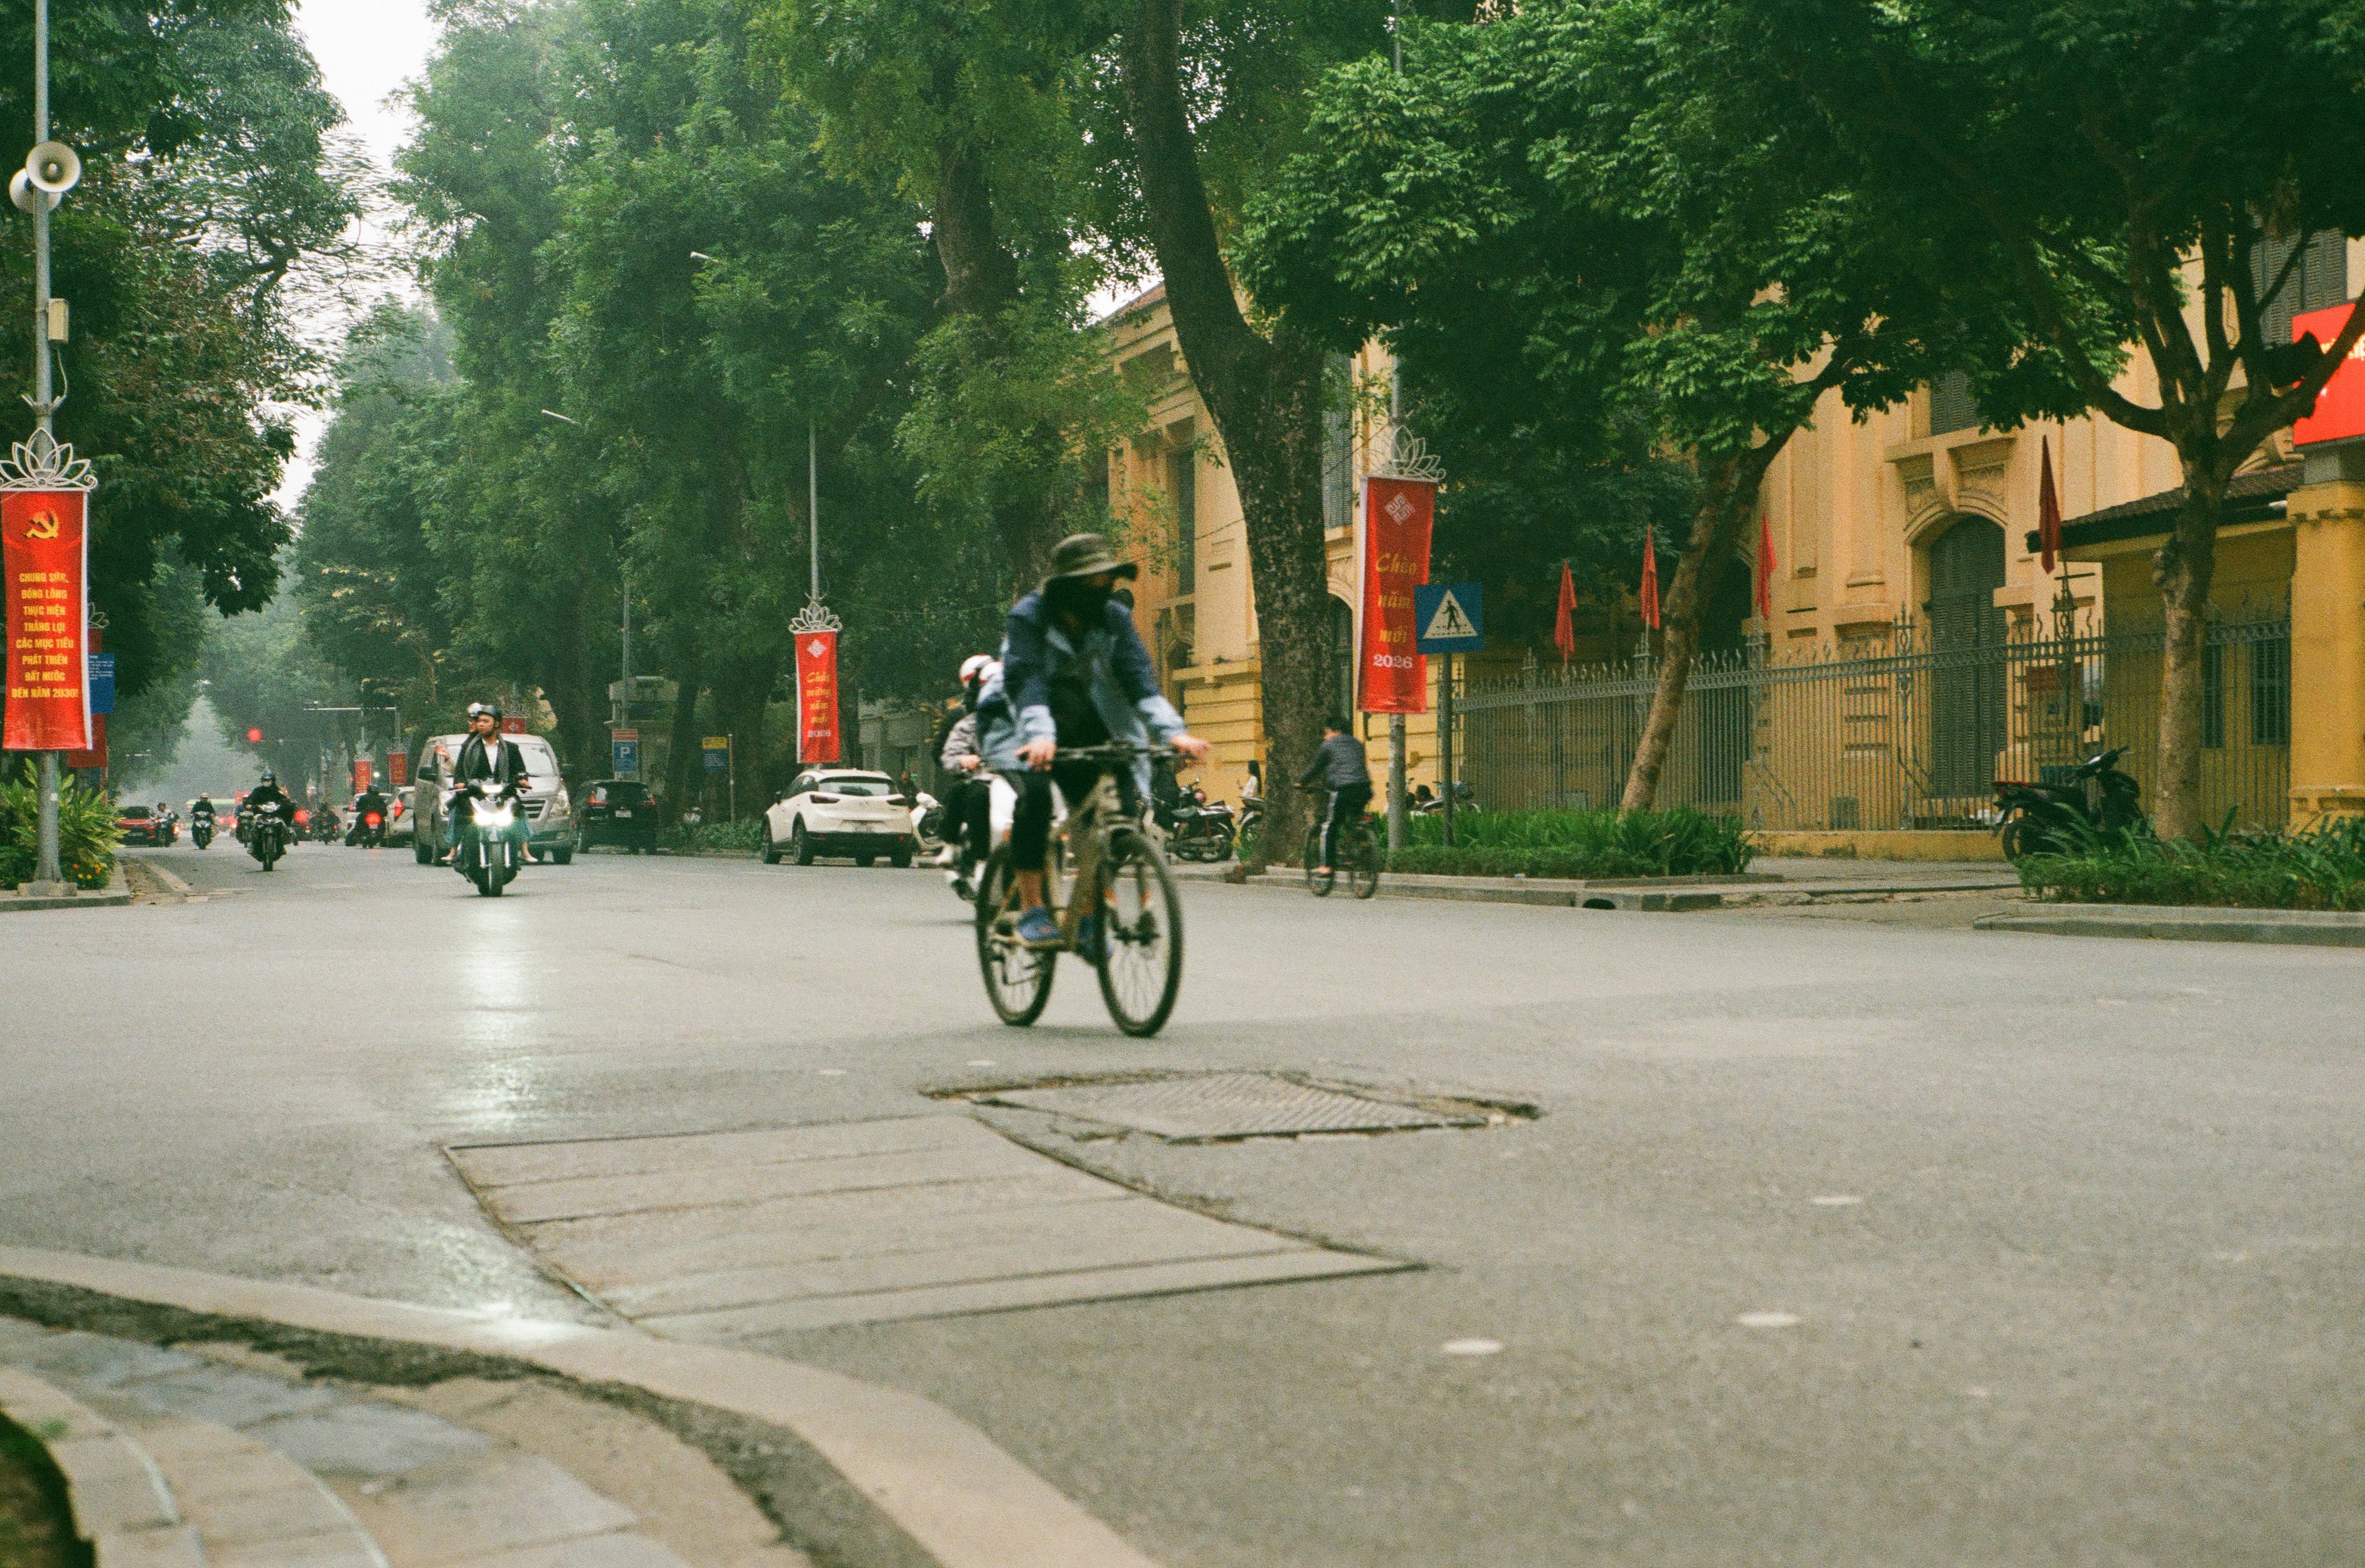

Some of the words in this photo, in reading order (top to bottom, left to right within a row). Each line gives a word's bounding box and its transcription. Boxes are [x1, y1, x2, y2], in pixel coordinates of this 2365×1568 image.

[19, 572, 47, 583] CHUNG
[20, 587, 43, 599] ĐỒNG
[45, 587, 67, 599] LÒNG
[1377, 589, 1411, 608] năm
[23, 605, 45, 617] THỰC
[46, 604, 66, 617] HIỆN
[23, 620, 51, 632] THẮNG
[52, 622, 66, 634] LỢI
[1378, 625, 1408, 644] mới
[16, 637, 33, 648] CÁC
[35, 639, 54, 650] MỤC
[56, 636, 74, 648] TIÊU
[22, 654, 42, 665] PHÁT
[45, 653, 69, 665] TRIỂN
[1373, 654, 1413, 669] 2026
[24, 670, 40, 682] ĐẤT
[42, 670, 66, 682] NƯỚC
[11, 686, 29, 698] ĐẾN
[31, 686, 51, 698] NĂM
[52, 688, 79, 698] 2030!
[620, 746, 630, 759] P
